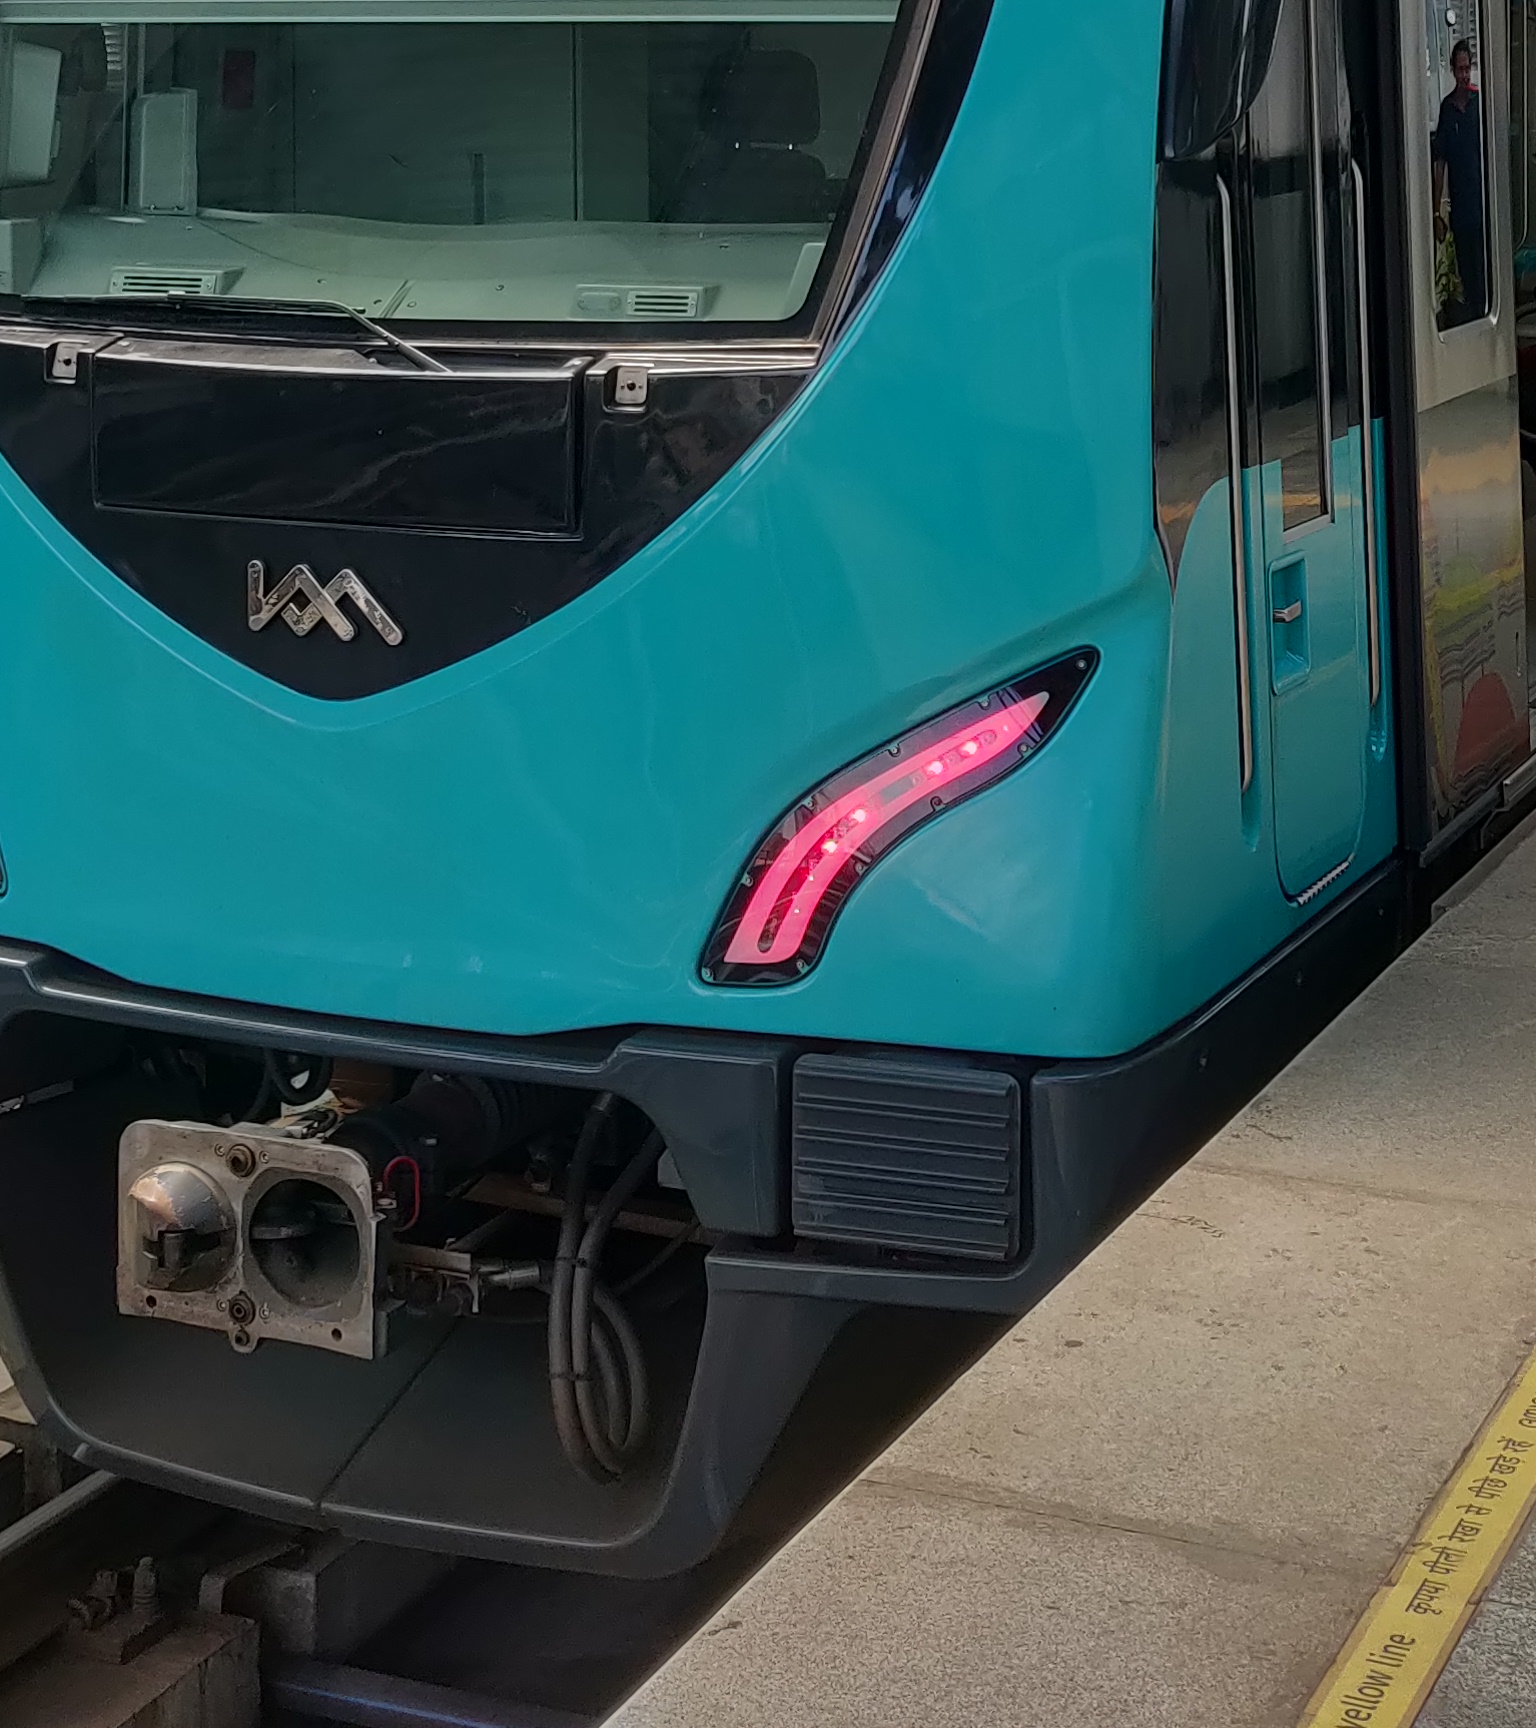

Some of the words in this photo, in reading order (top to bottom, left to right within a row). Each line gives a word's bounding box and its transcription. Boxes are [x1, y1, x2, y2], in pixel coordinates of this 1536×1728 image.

[1467, 1475, 1508, 1500] पीछे
[1455, 1503, 1493, 1516] से
[1437, 1517, 1484, 1543] रेखा
[1422, 1546, 1468, 1575] पीली
[1405, 1577, 1451, 1616] कृपया
[1365, 1633, 1416, 1669] line
